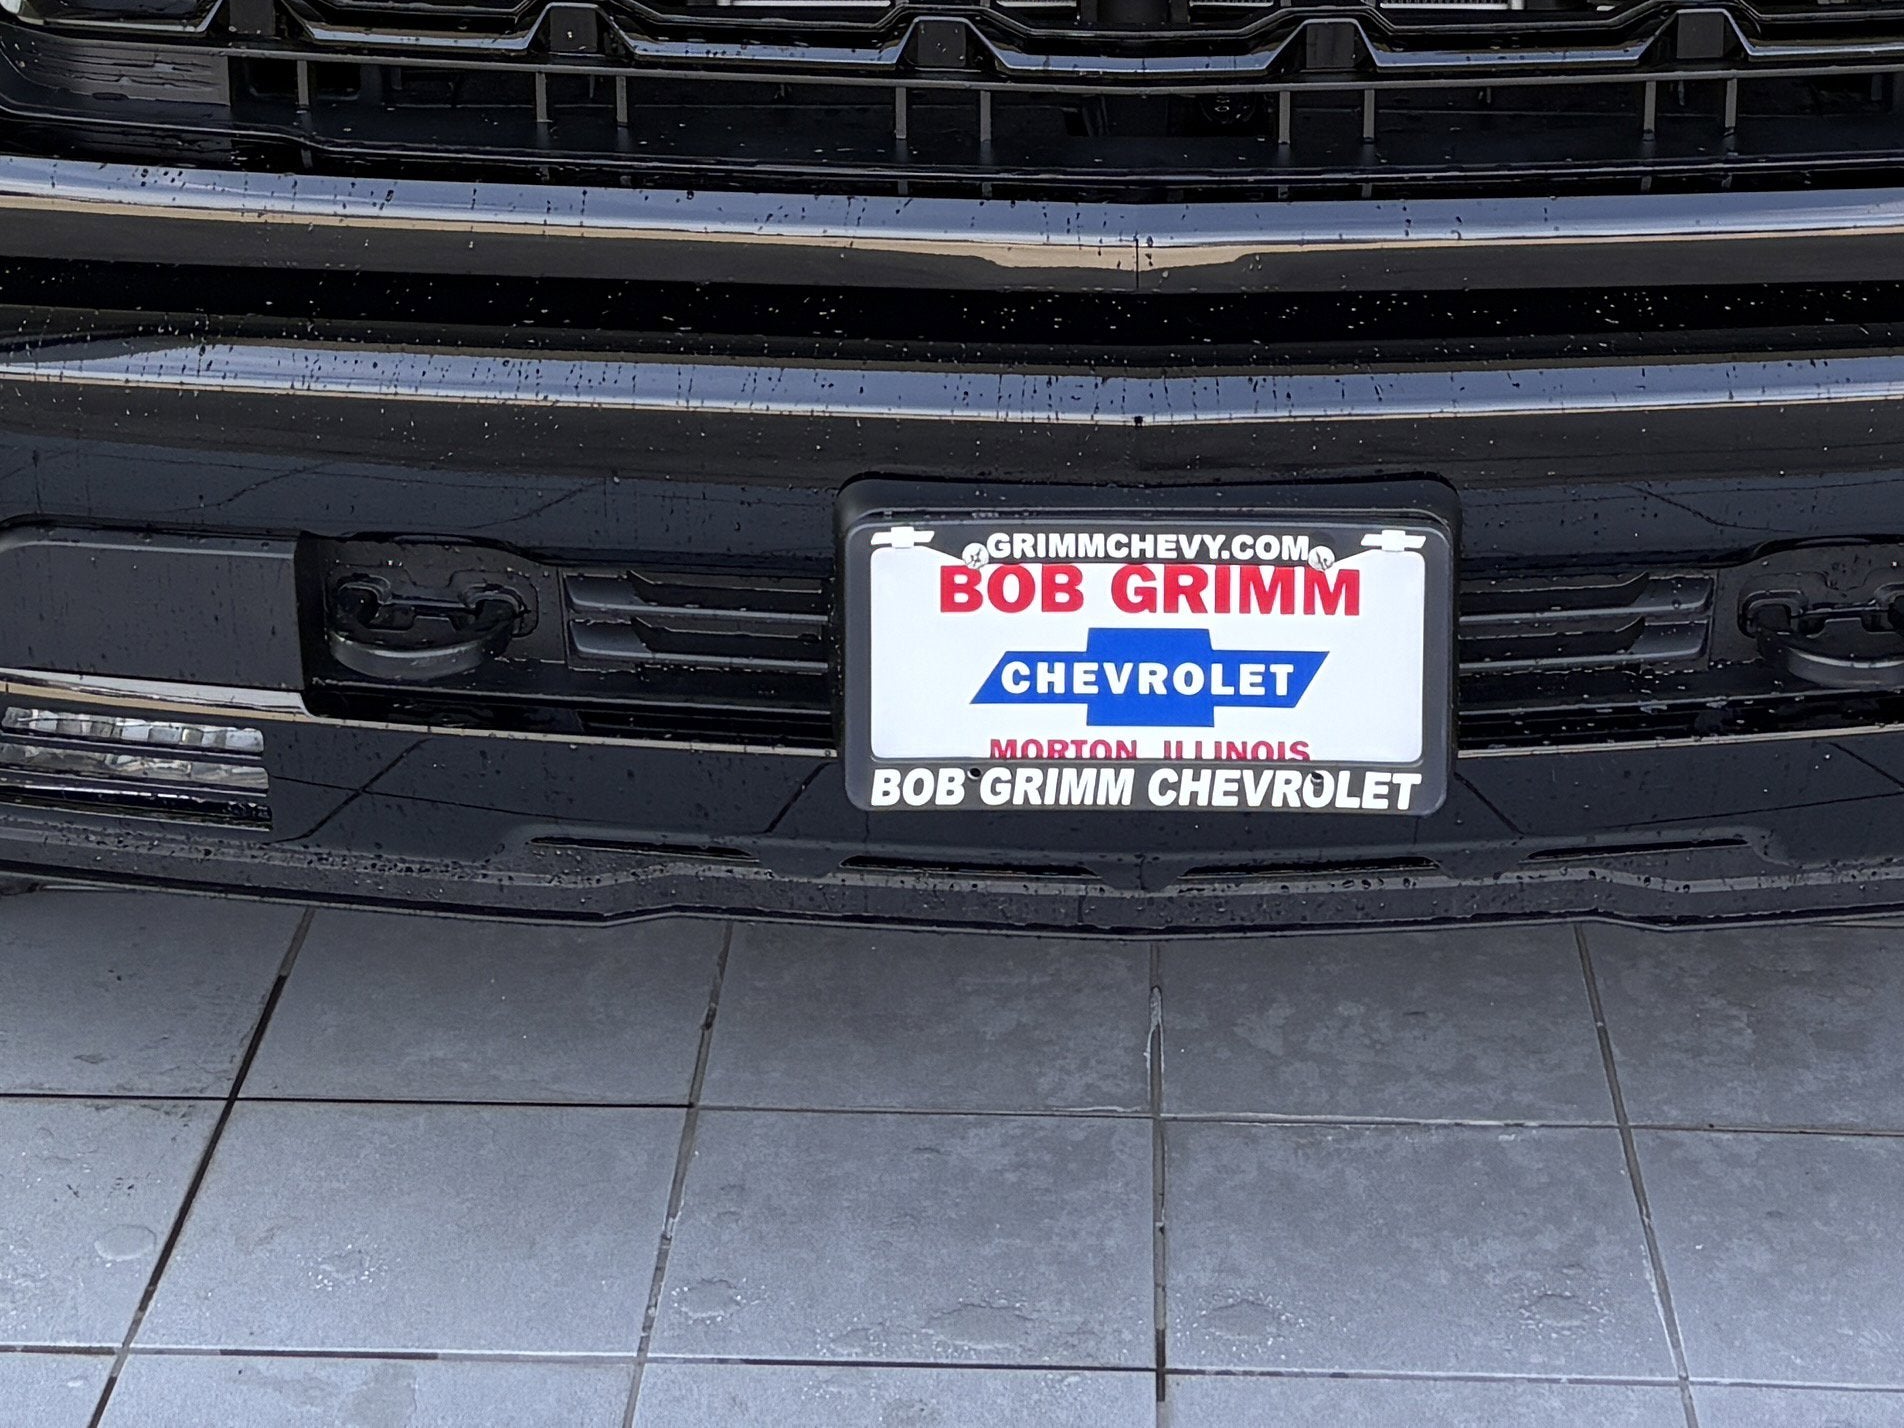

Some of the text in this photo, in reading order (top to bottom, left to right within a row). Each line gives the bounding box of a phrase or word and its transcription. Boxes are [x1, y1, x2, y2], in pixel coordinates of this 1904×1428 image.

[987, 533, 1310, 561] GRIMMCHEVY.COM
[940, 564, 1360, 616] BOB GRIMM
[1001, 661, 1294, 696] CHEVROLET
[989, 738, 1138, 761] MORTON
[870, 768, 1421, 810] BOB GRIMM CHEVROLET
